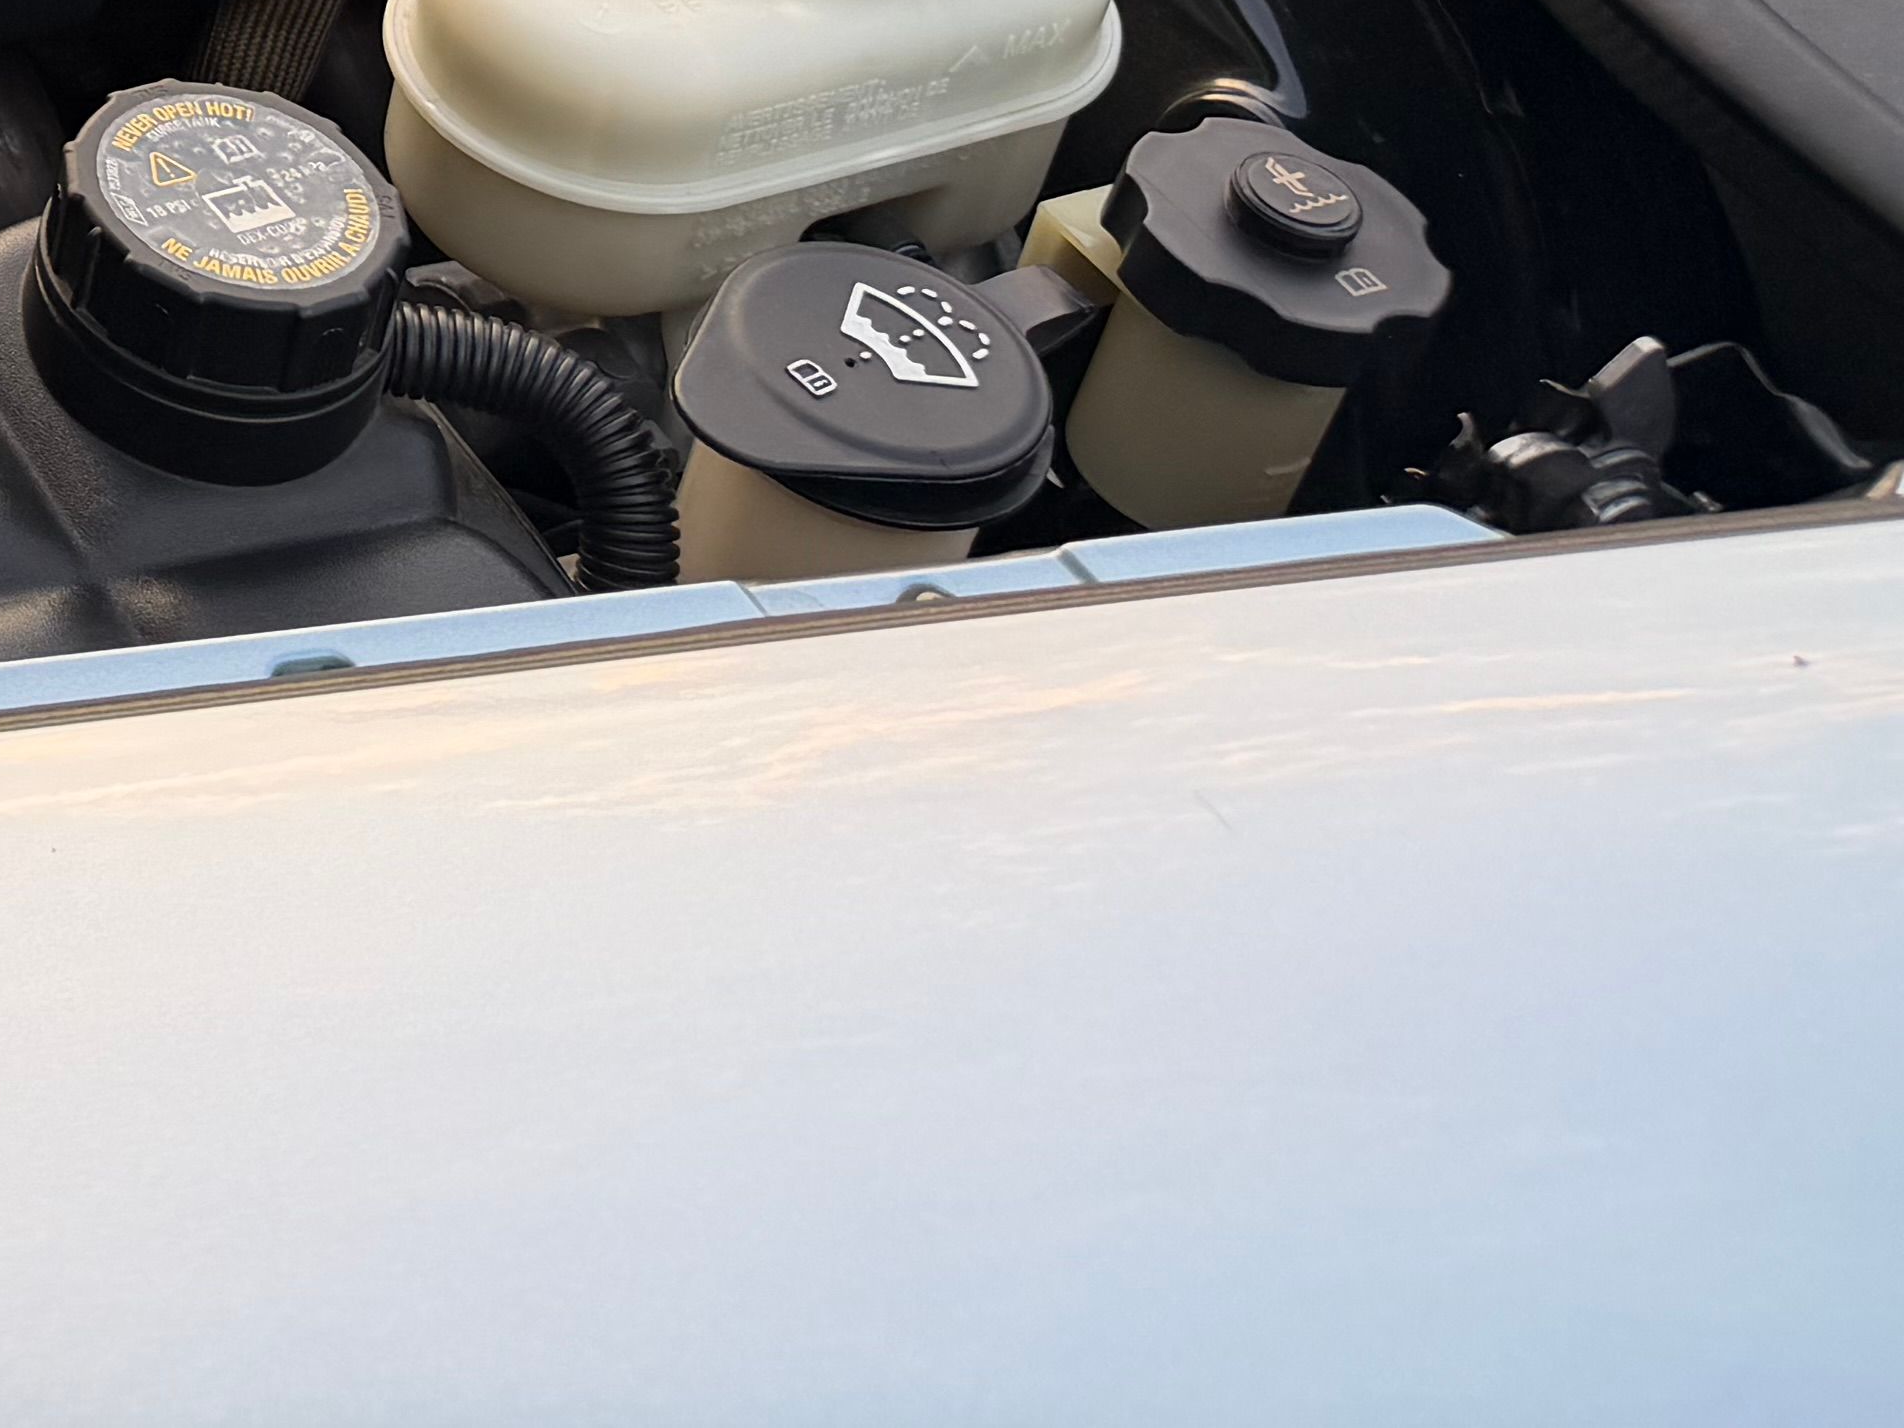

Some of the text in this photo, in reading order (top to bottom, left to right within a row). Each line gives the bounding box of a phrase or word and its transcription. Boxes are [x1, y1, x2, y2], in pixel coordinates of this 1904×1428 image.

[111, 101, 252, 152] NEVER OPEN HOT!
[161, 237, 193, 262] NE
[193, 255, 279, 284] JAMAIS
[280, 251, 347, 284] OUVRIR
[343, 188, 371, 244] CHAUD!
[237, 217, 307, 246] DEX-CO
